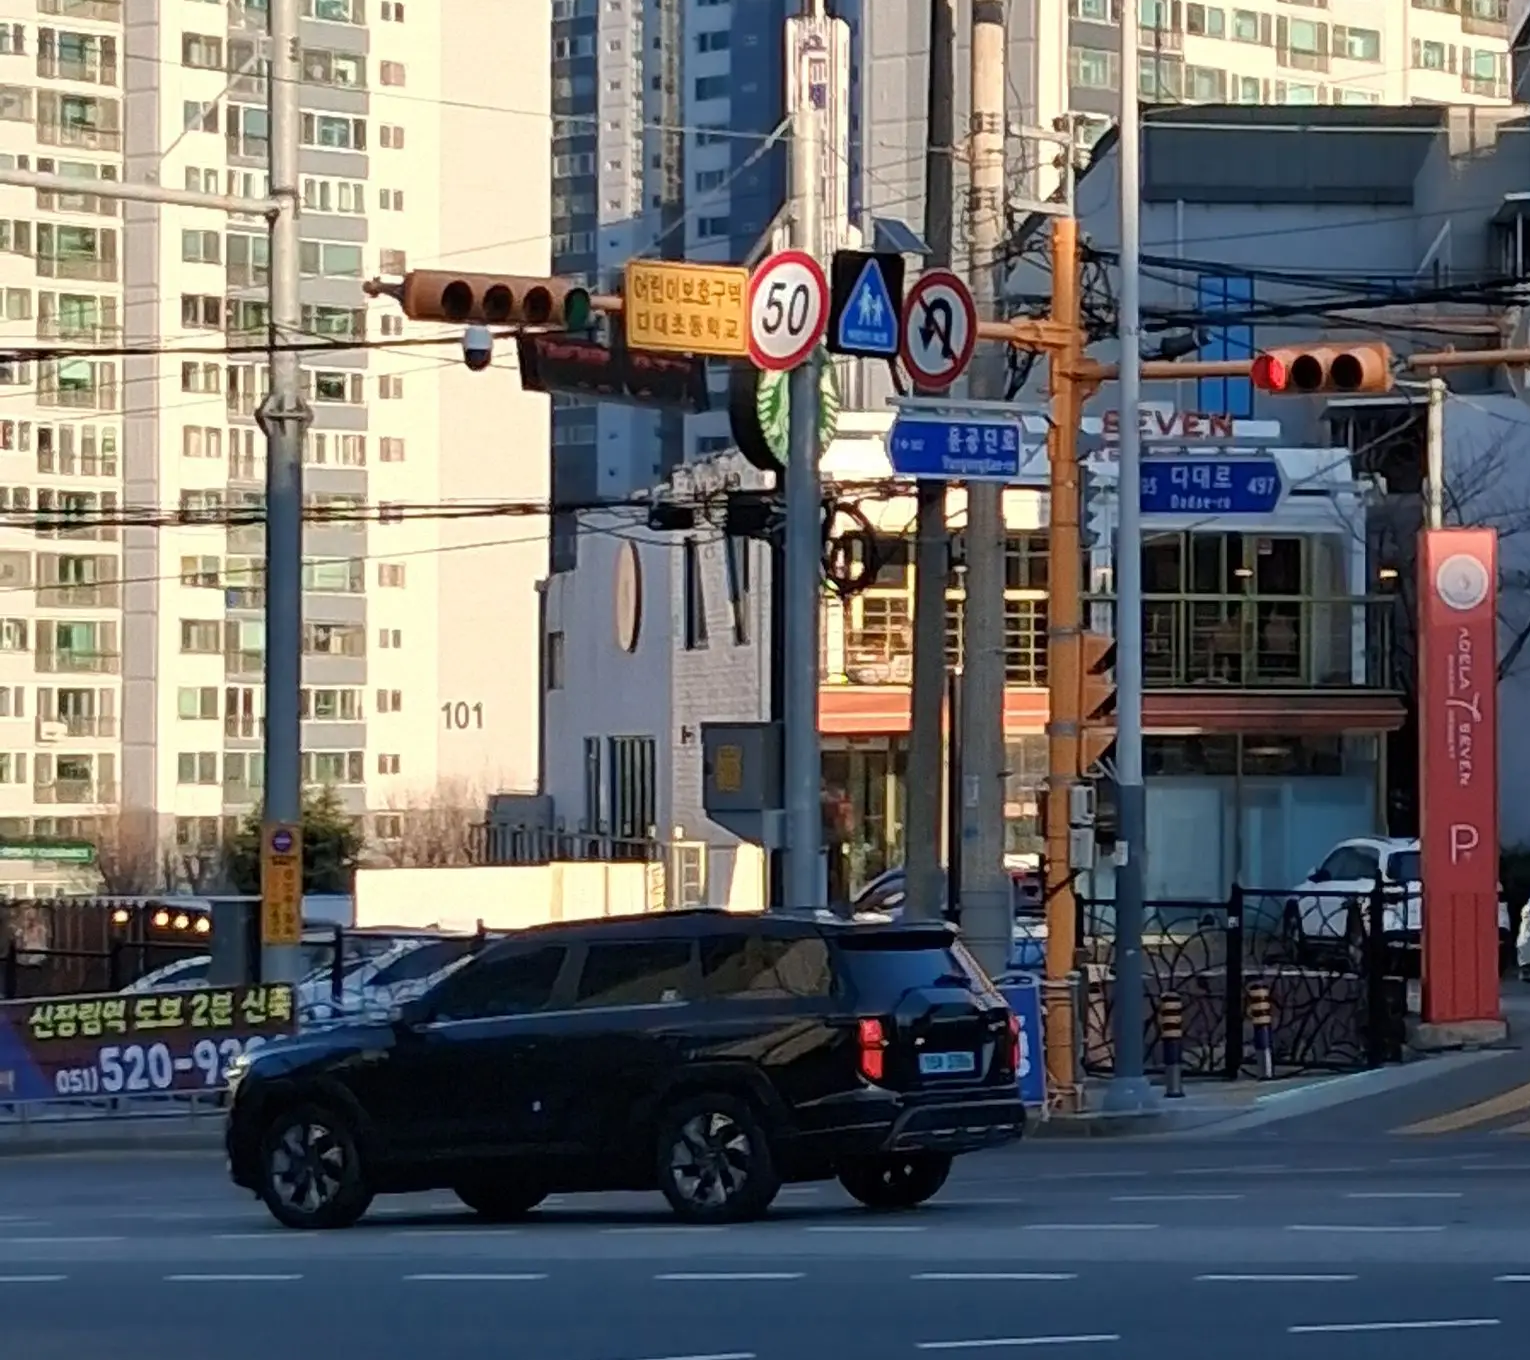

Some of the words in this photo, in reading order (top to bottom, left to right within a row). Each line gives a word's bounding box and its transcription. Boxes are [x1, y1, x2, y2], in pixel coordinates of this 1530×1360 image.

[633, 272, 741, 308] 어린이보호구역
[636, 311, 739, 339] 다대초등학교
[761, 282, 819, 336] 50
[1170, 465, 1233, 489] 다대로
[1247, 476, 1275, 495] 497
[441, 701, 483, 729] 101
[1451, 824, 1478, 864] P
[29, 999, 127, 1039] 신장림역
[134, 996, 185, 1029] 도보
[190, 992, 235, 1027] 2분
